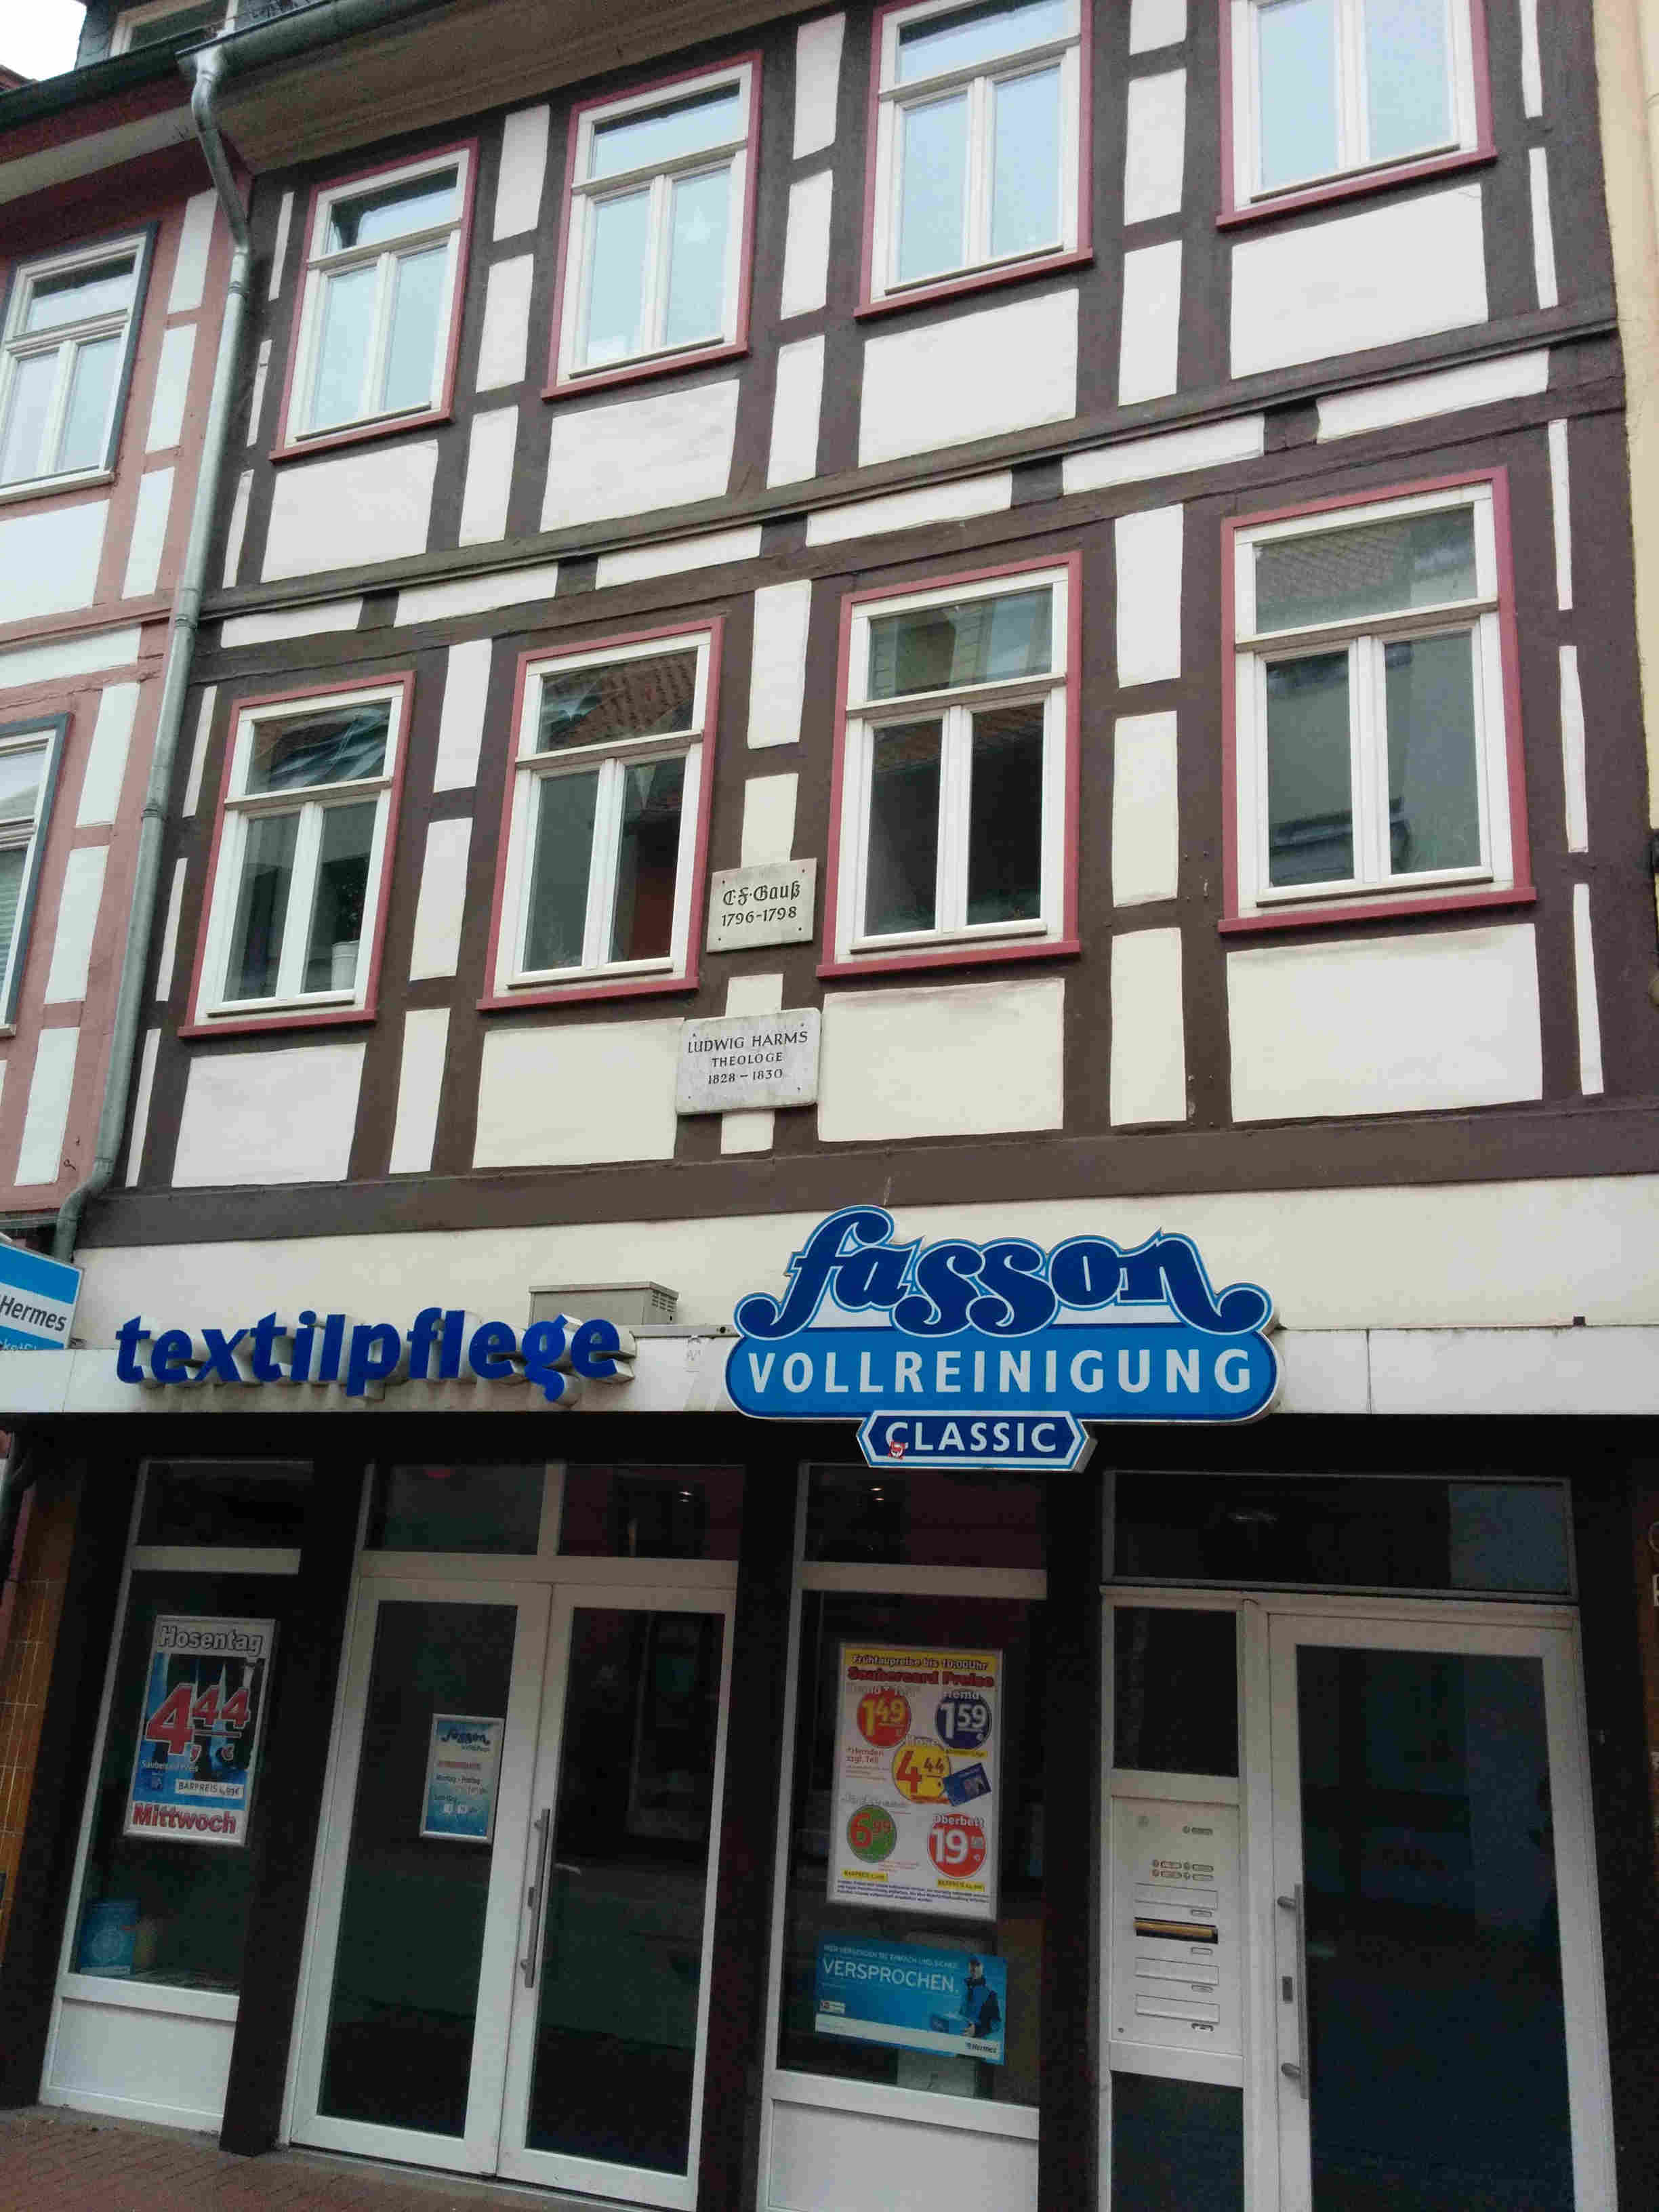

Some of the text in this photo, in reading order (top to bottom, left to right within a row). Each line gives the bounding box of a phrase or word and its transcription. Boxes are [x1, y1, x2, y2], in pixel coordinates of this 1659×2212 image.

[721, 906, 798, 926] 1796-1798
[688, 1031, 808, 1054] LUDWIG HARMS
[712, 1052, 783, 1067] THEOLOGE
[708, 1072, 735, 1085] 1828
[753, 1069, 783, 1080] 1830
[739, 1210, 1267, 1336] fasson
[0, 1295, 66, 1332] Hermes
[115, 1307, 624, 1403] textilpflege
[748, 1348, 1252, 1395] VOLLREINIGUNG
[885, 1422, 1057, 1454] CLASSIC
[158, 1625, 264, 1657] Hosentag
[132, 1801, 237, 1834] Mittwoch
[822, 1958, 960, 1992] VERSPROCHEN.
